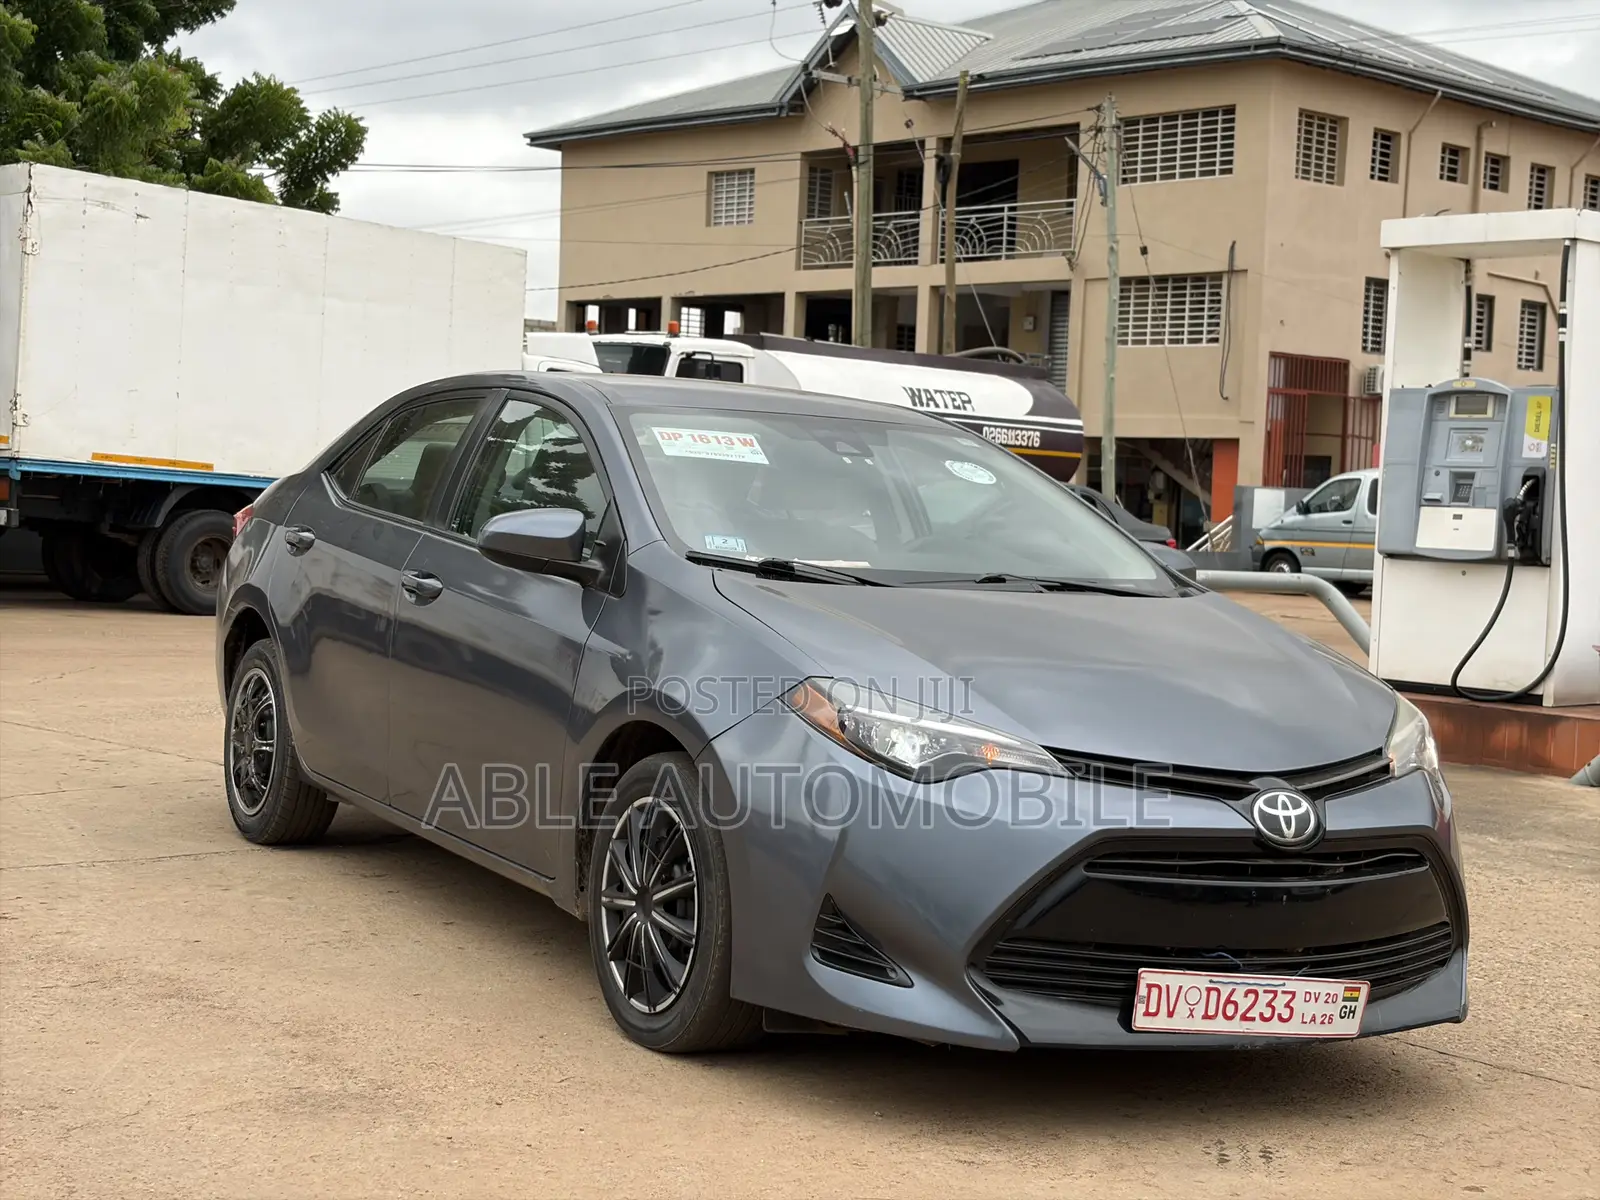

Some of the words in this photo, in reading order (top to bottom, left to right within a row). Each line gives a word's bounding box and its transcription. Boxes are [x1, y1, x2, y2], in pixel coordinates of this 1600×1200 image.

[901, 386, 975, 412] WATER
[1533, 411, 1543, 433] DIESEL
[658, 431, 683, 441] DP
[687, 433, 735, 446] 1613
[736, 437, 755, 448] W
[982, 426, 1041, 448] 0266113376
[1142, 983, 1183, 1018] DV
[1201, 987, 1297, 1024] D6233
[1303, 991, 1321, 1004] DV
[1323, 992, 1339, 1005] 20
[1300, 1012, 1317, 1025] LA
[1319, 1012, 1335, 1025] 26
[1338, 1004, 1358, 1020] GH
